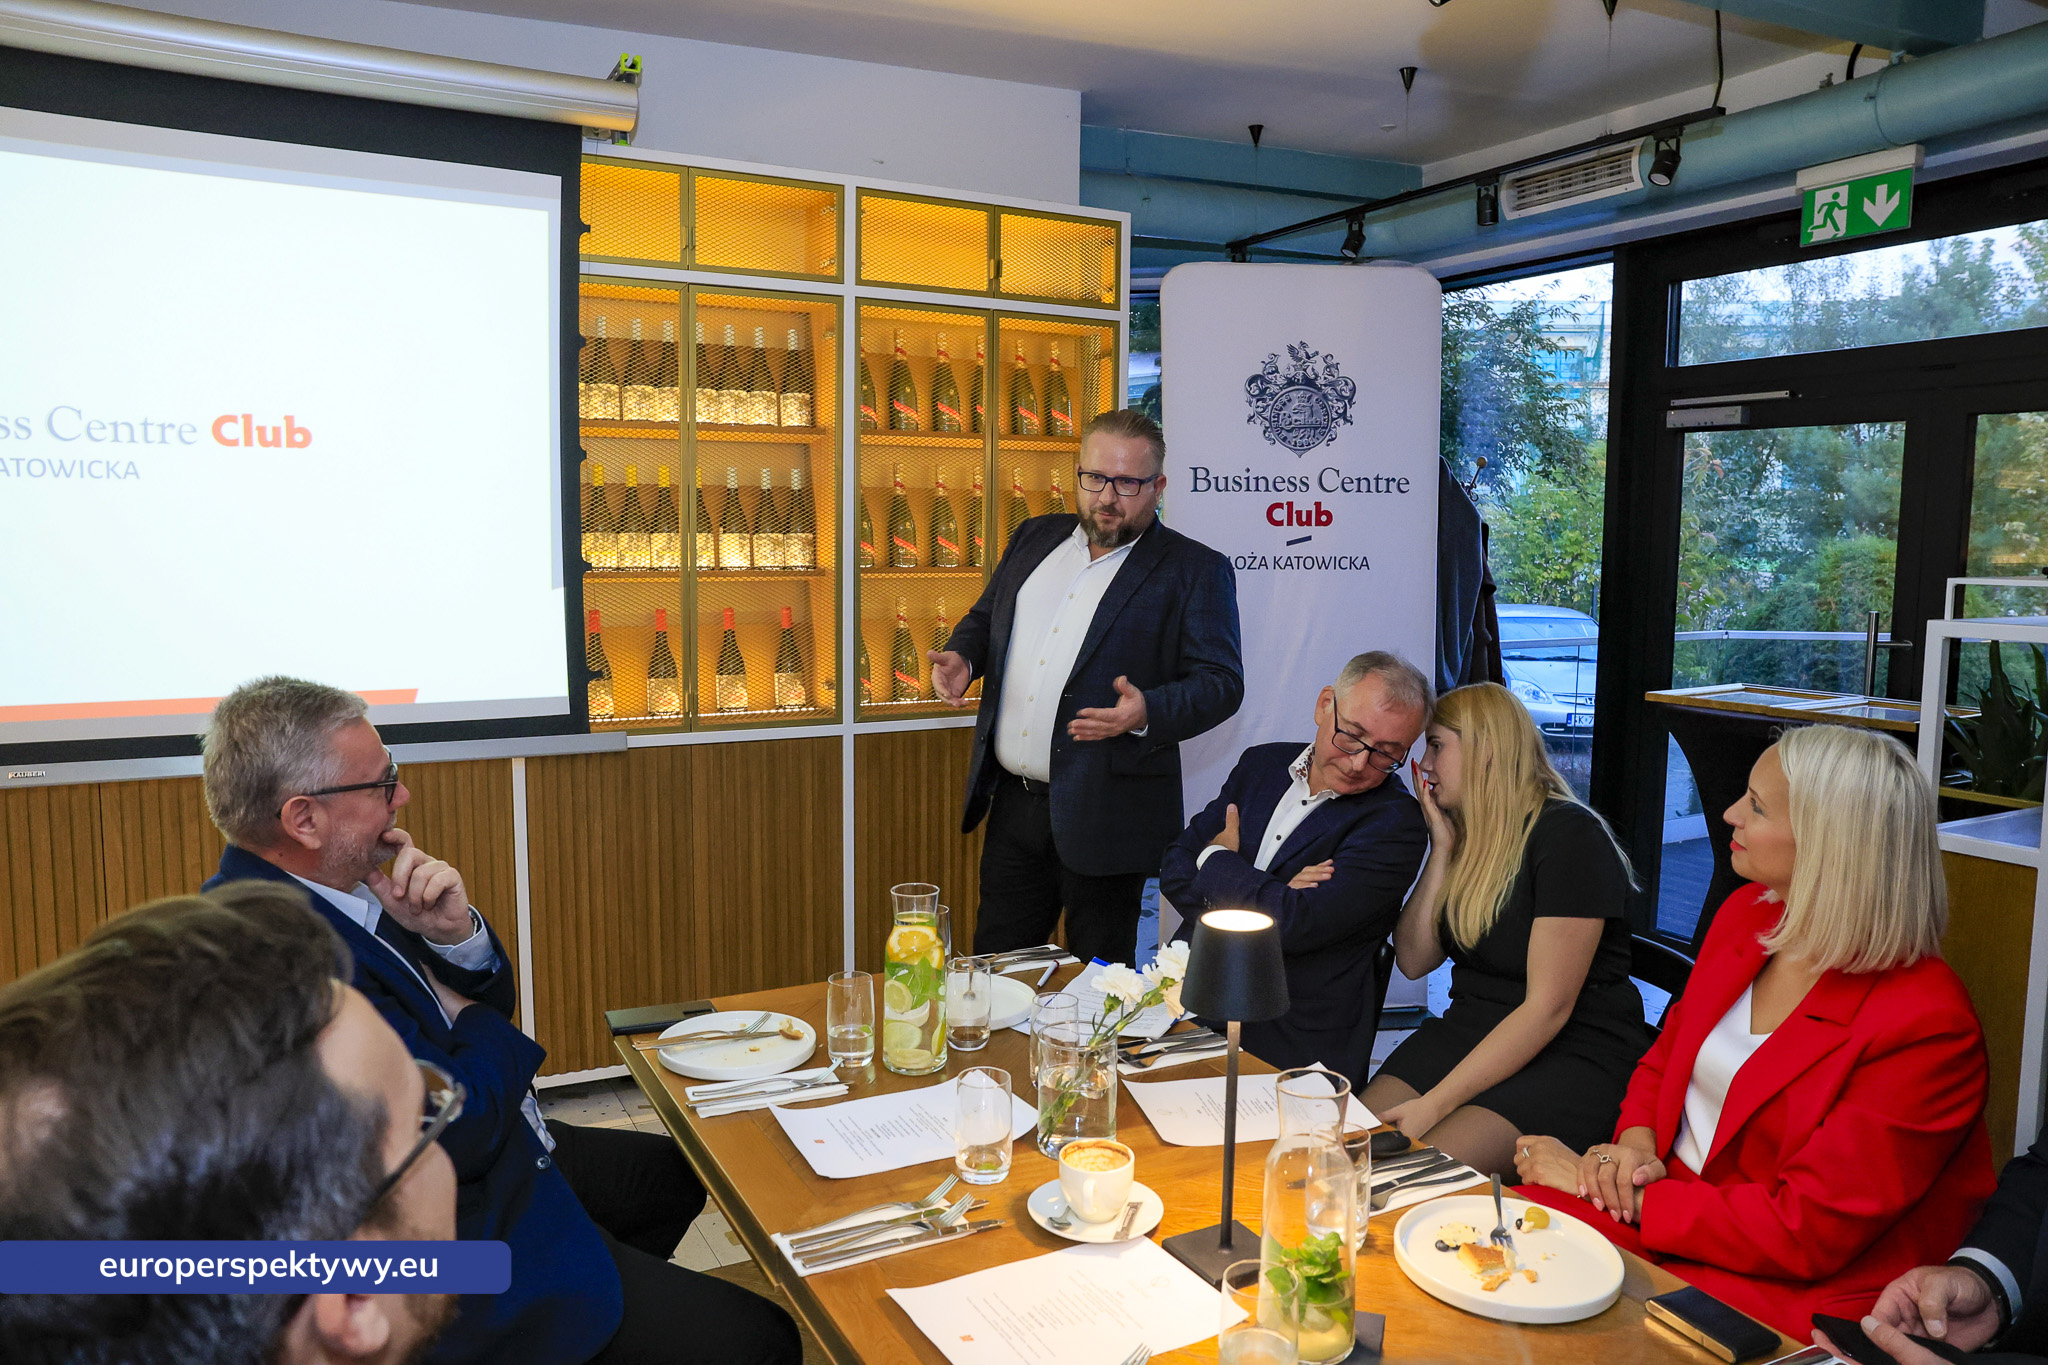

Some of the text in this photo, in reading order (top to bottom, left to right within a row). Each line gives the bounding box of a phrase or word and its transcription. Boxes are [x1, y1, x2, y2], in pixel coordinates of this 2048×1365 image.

[47, 405, 198, 446] Centre
[211, 413, 312, 449] Club
[1189, 466, 1410, 494] Business Centre
[1266, 500, 1333, 527] Club
[1273, 556, 1371, 571] KATOWICKA
